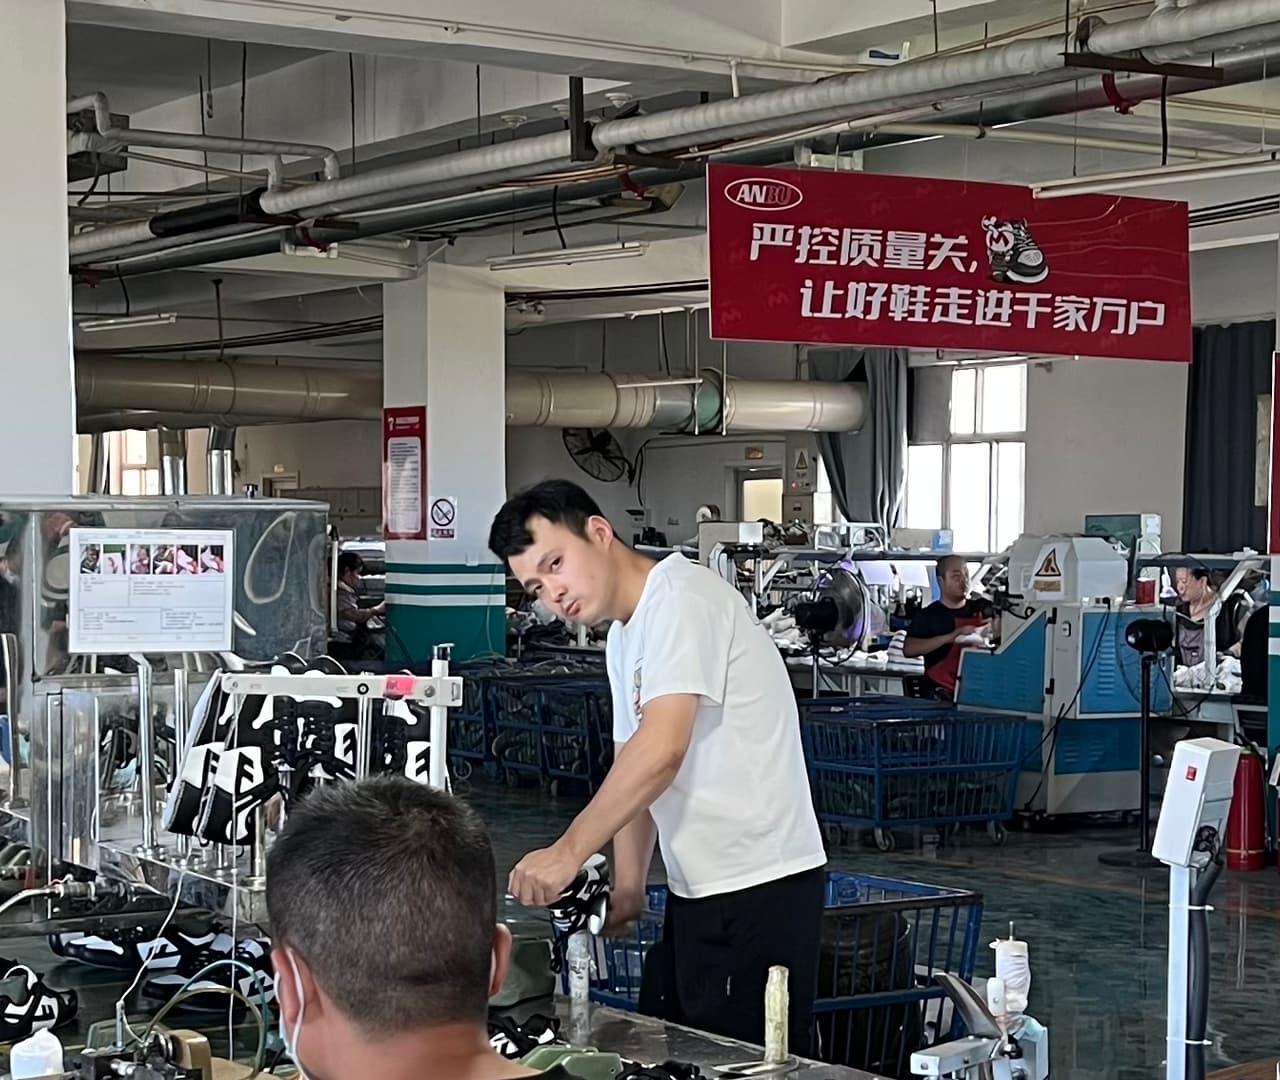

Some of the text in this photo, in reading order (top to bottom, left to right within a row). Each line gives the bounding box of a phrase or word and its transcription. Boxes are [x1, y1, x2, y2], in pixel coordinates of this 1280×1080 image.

[749, 222, 978, 274] 严控质量关,
[799, 278, 1167, 336] 让好鞋走进千家万户
